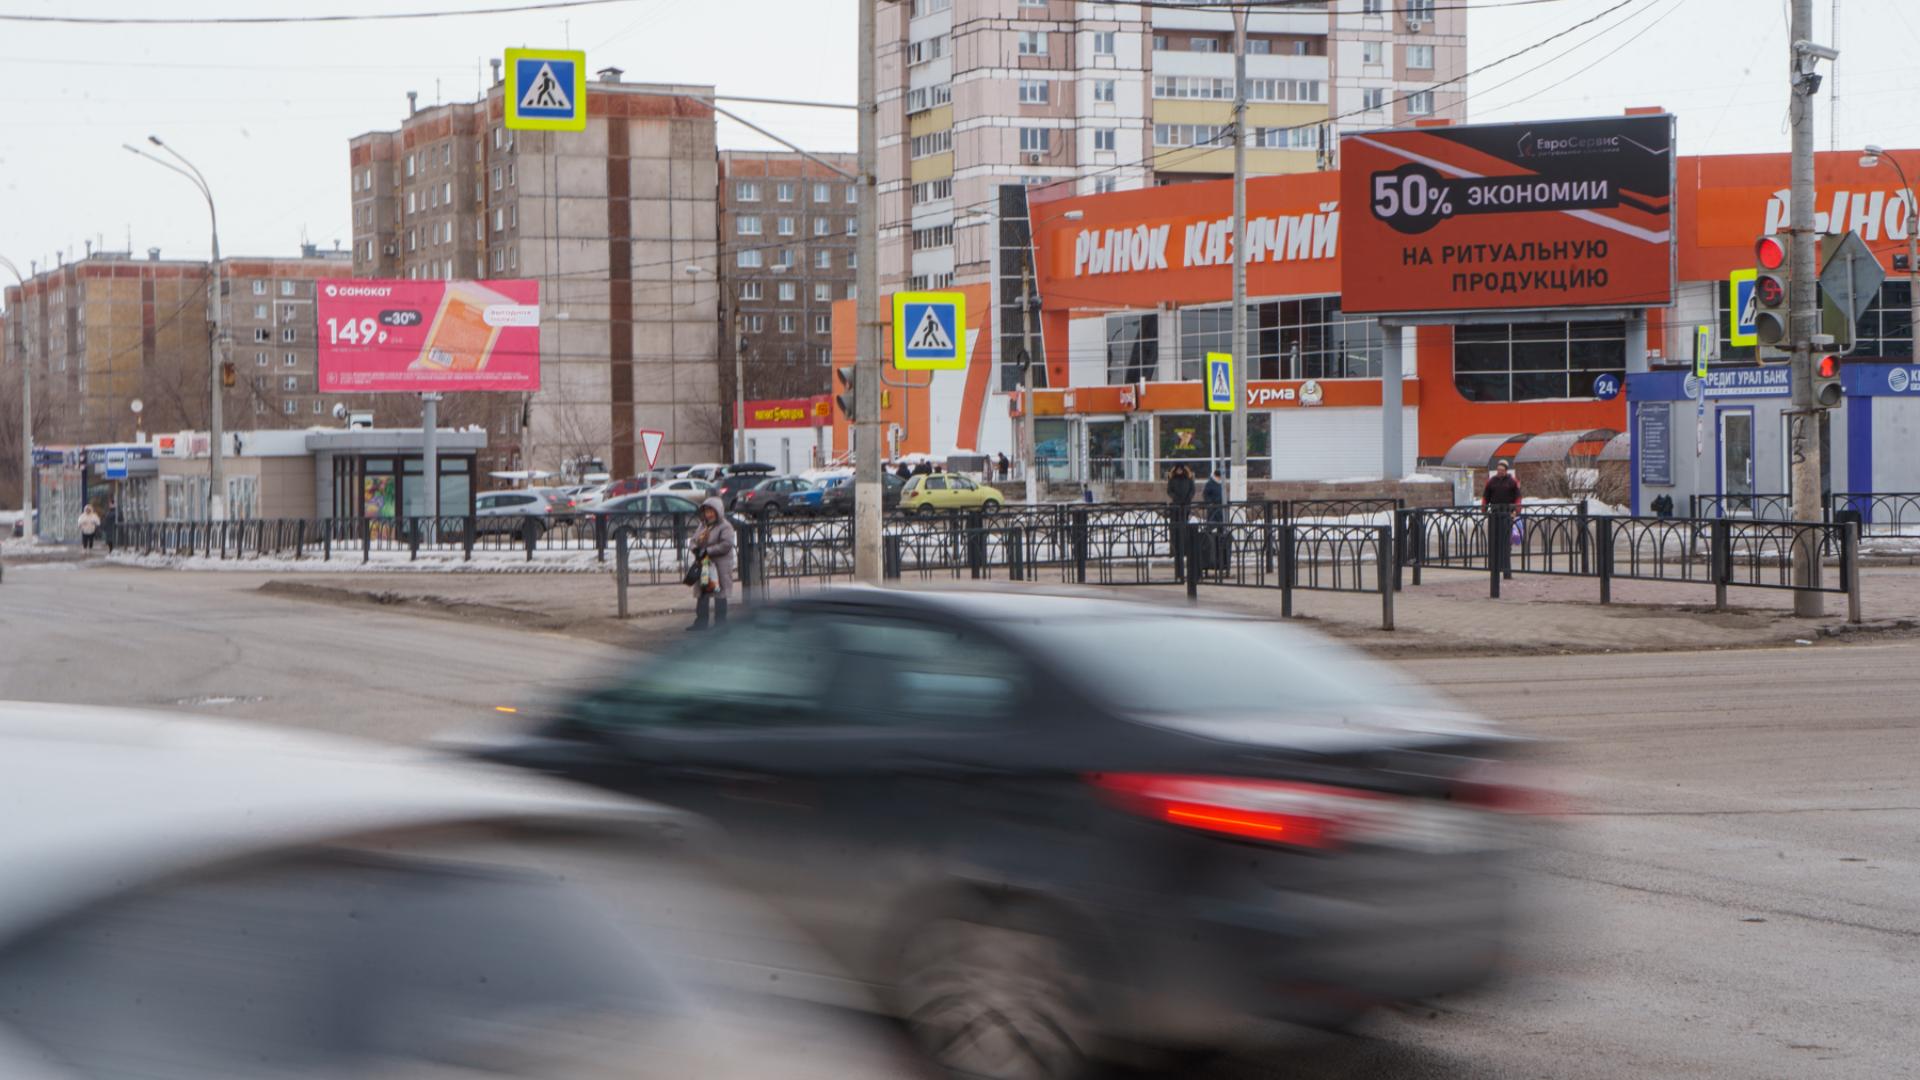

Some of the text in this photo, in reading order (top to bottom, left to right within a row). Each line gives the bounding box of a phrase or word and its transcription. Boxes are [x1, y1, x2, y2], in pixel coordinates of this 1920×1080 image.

[1537, 136, 1619, 151] ЕвроСервис
[1374, 174, 1609, 218] 50% ЭКОНОМИИ
[1764, 187, 1920, 241] РЫНО
[1074, 223, 1170, 277] РЫНОК
[1402, 240, 1609, 266] НА РИТУАЛЬНУЮ
[339, 286, 392, 297] самокат
[1452, 268, 1609, 293] ПРОДУКЦИЮ
[1738, 371, 1762, 386] УРАЛ
[1763, 369, 1789, 384] БАНК
[1247, 388, 1296, 406] урма
